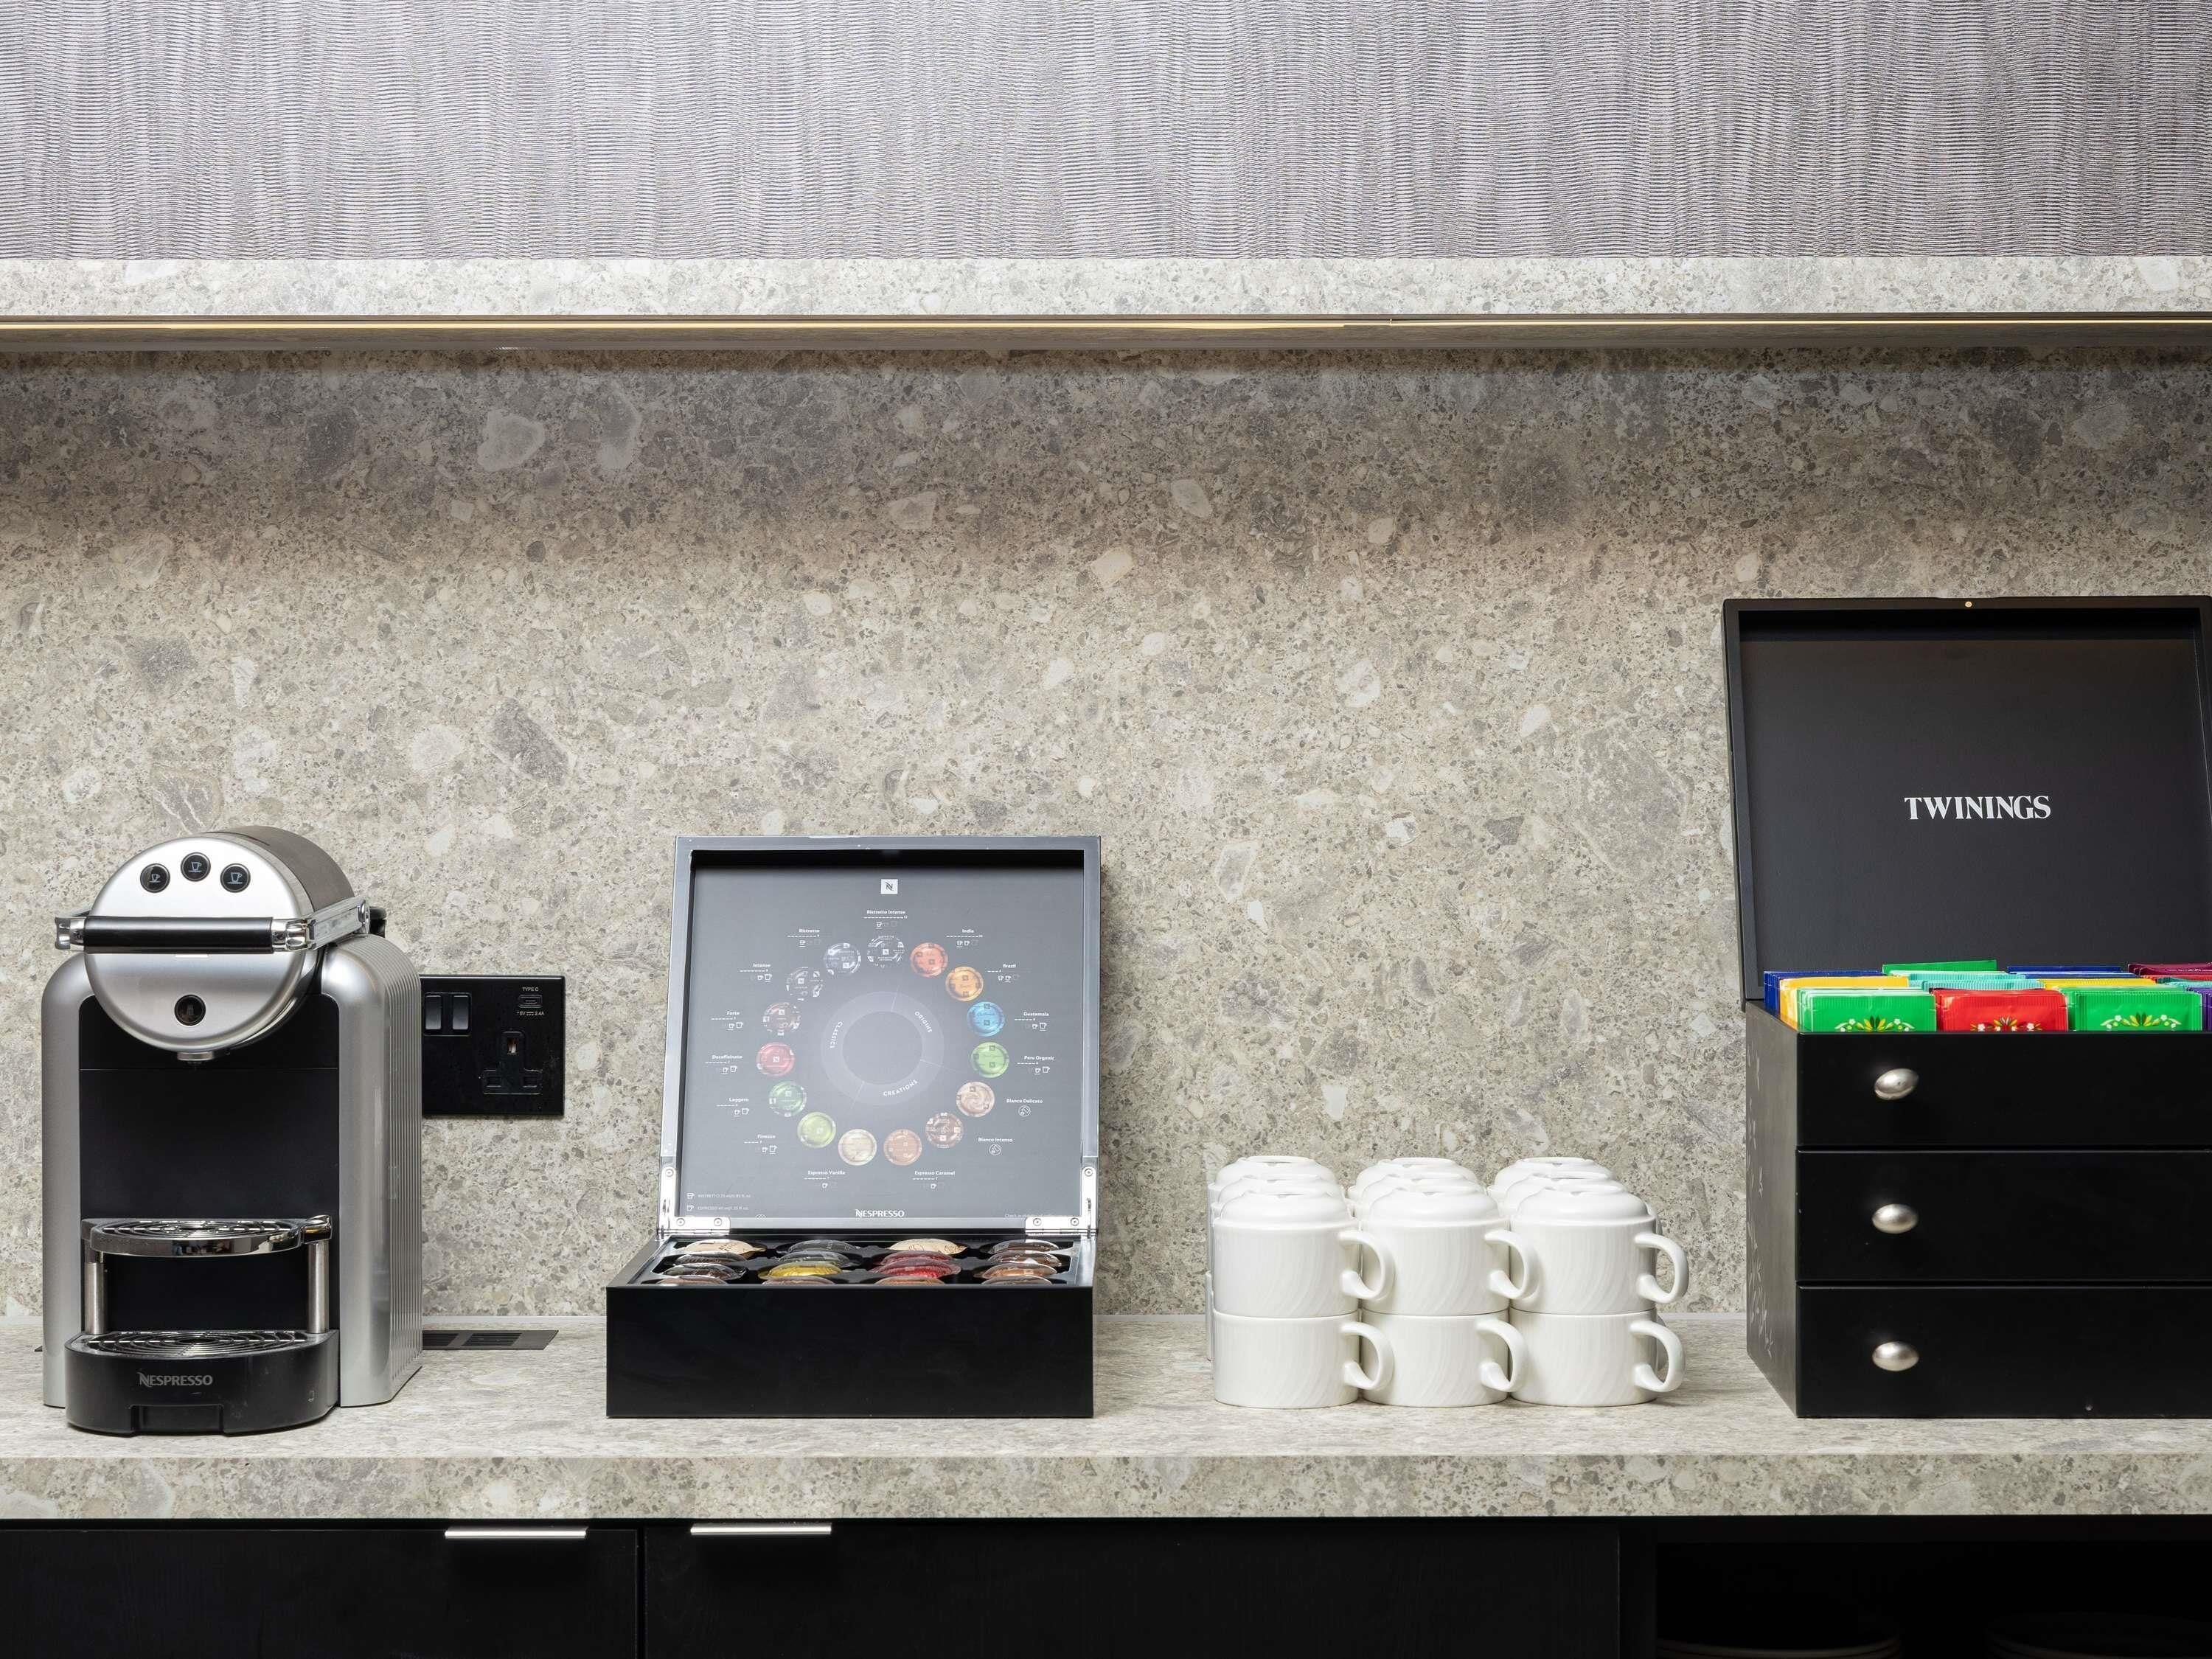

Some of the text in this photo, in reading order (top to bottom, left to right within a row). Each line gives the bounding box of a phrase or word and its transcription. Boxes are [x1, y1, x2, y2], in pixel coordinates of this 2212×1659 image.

[1904, 795, 2052, 821] TWININGS
[914, 1010, 933, 1033] ORIGINS
[830, 1020, 844, 1048] CLASSICS
[883, 1079, 919, 1097] CREATIONS
[855, 1209, 905, 1218] NESPRESSO
[136, 1371, 214, 1388] NESPRESSO
